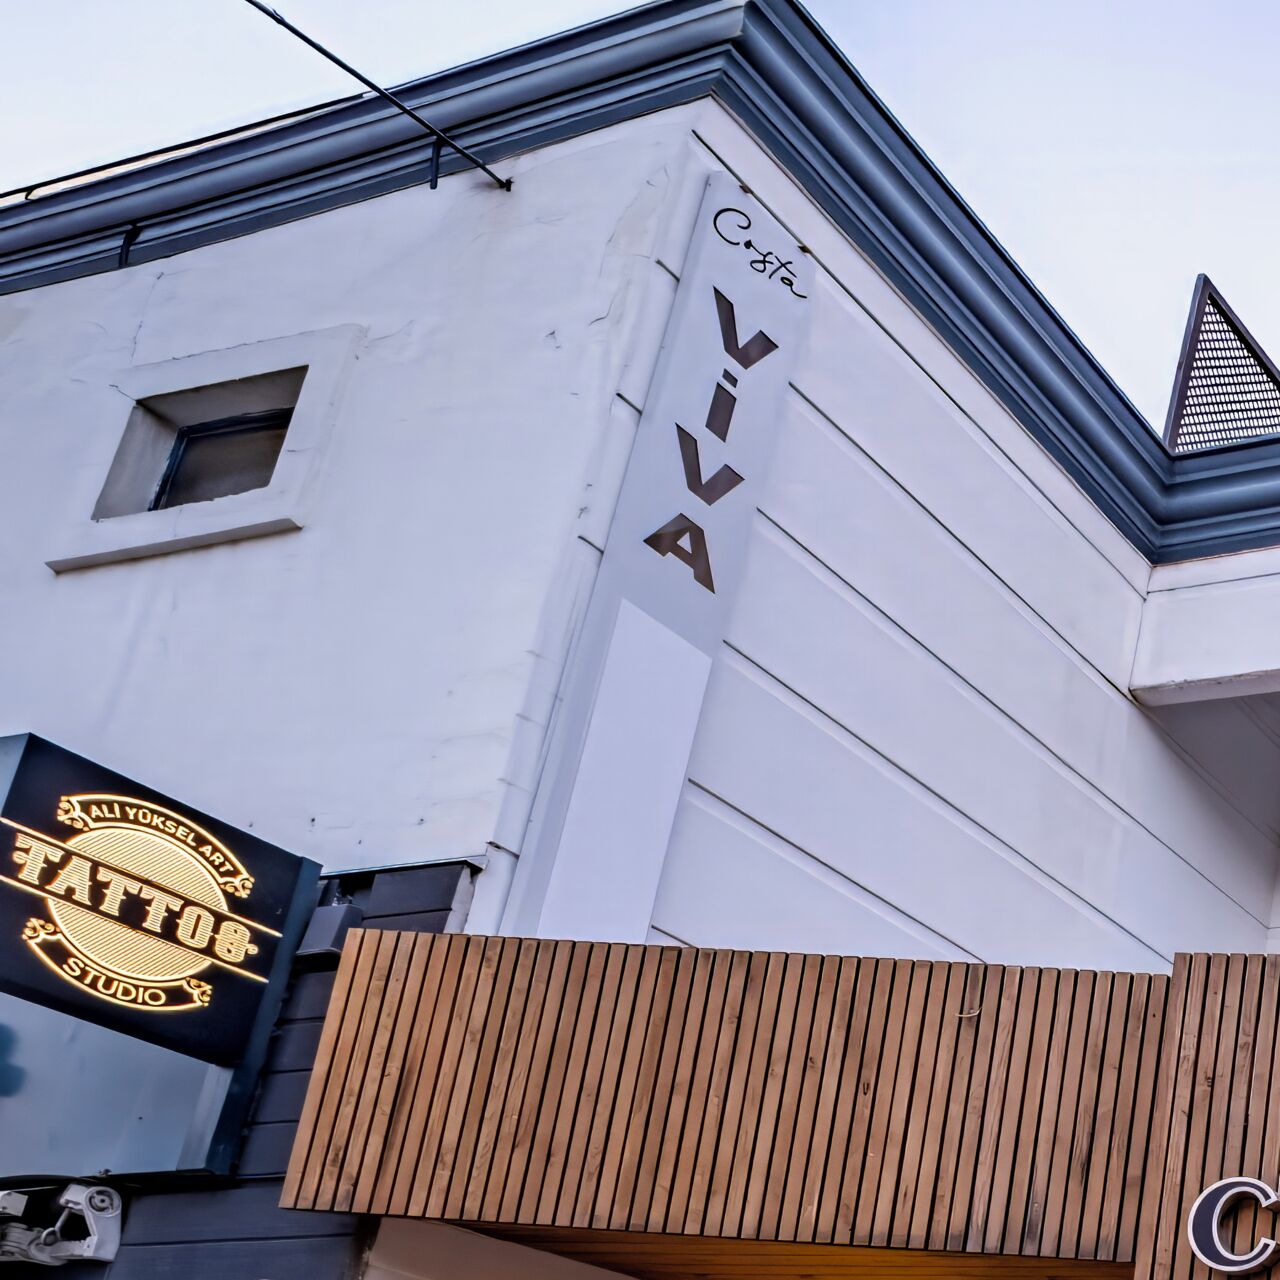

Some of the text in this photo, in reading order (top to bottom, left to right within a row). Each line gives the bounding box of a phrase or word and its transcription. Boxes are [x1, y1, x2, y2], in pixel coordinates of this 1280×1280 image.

[713, 207, 808, 299] Costa
[199, 844, 234, 872] ART
[12, 833, 259, 963] TATTOS
[62, 957, 166, 1006] STUDIO
